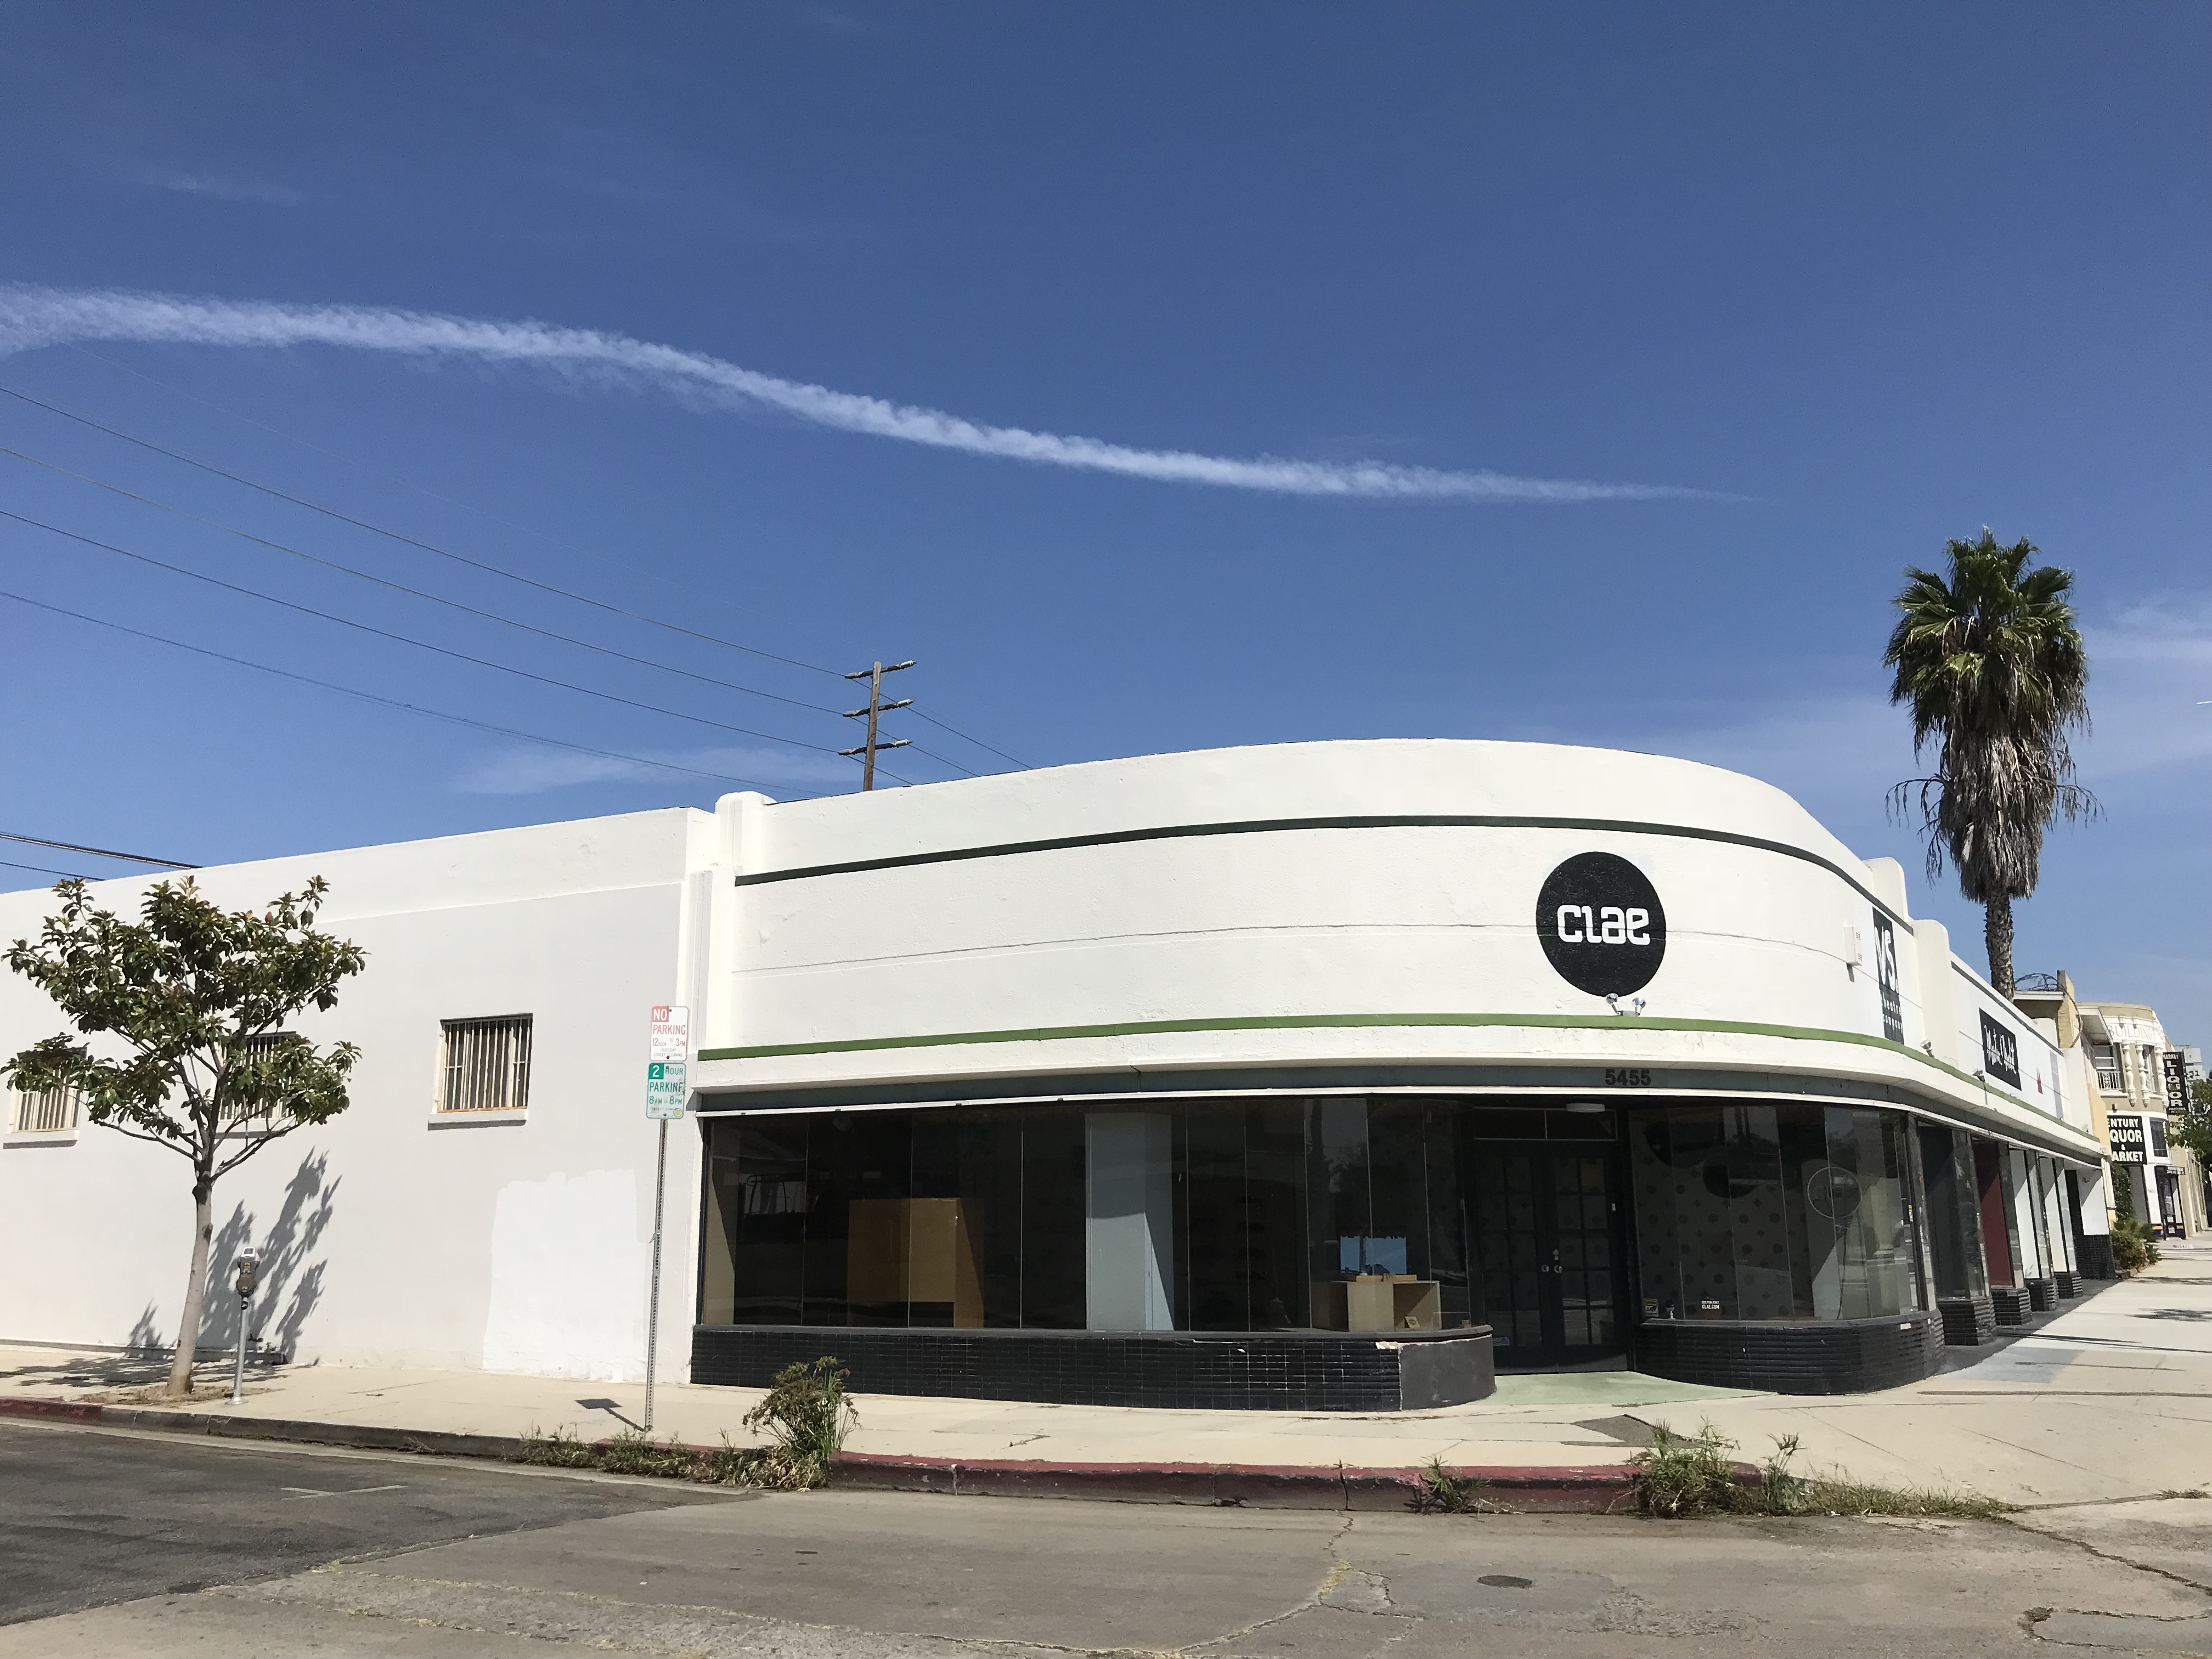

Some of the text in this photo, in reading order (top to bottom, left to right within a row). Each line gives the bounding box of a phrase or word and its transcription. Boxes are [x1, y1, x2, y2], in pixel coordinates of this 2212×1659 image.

[653, 1008, 668, 1021] NO
[653, 1024, 686, 1035] PARKING
[2107, 1024, 2153, 1040] BUILDING
[652, 1065, 684, 1077] 2 HOUR
[1605, 1069, 1652, 1086] 5455
